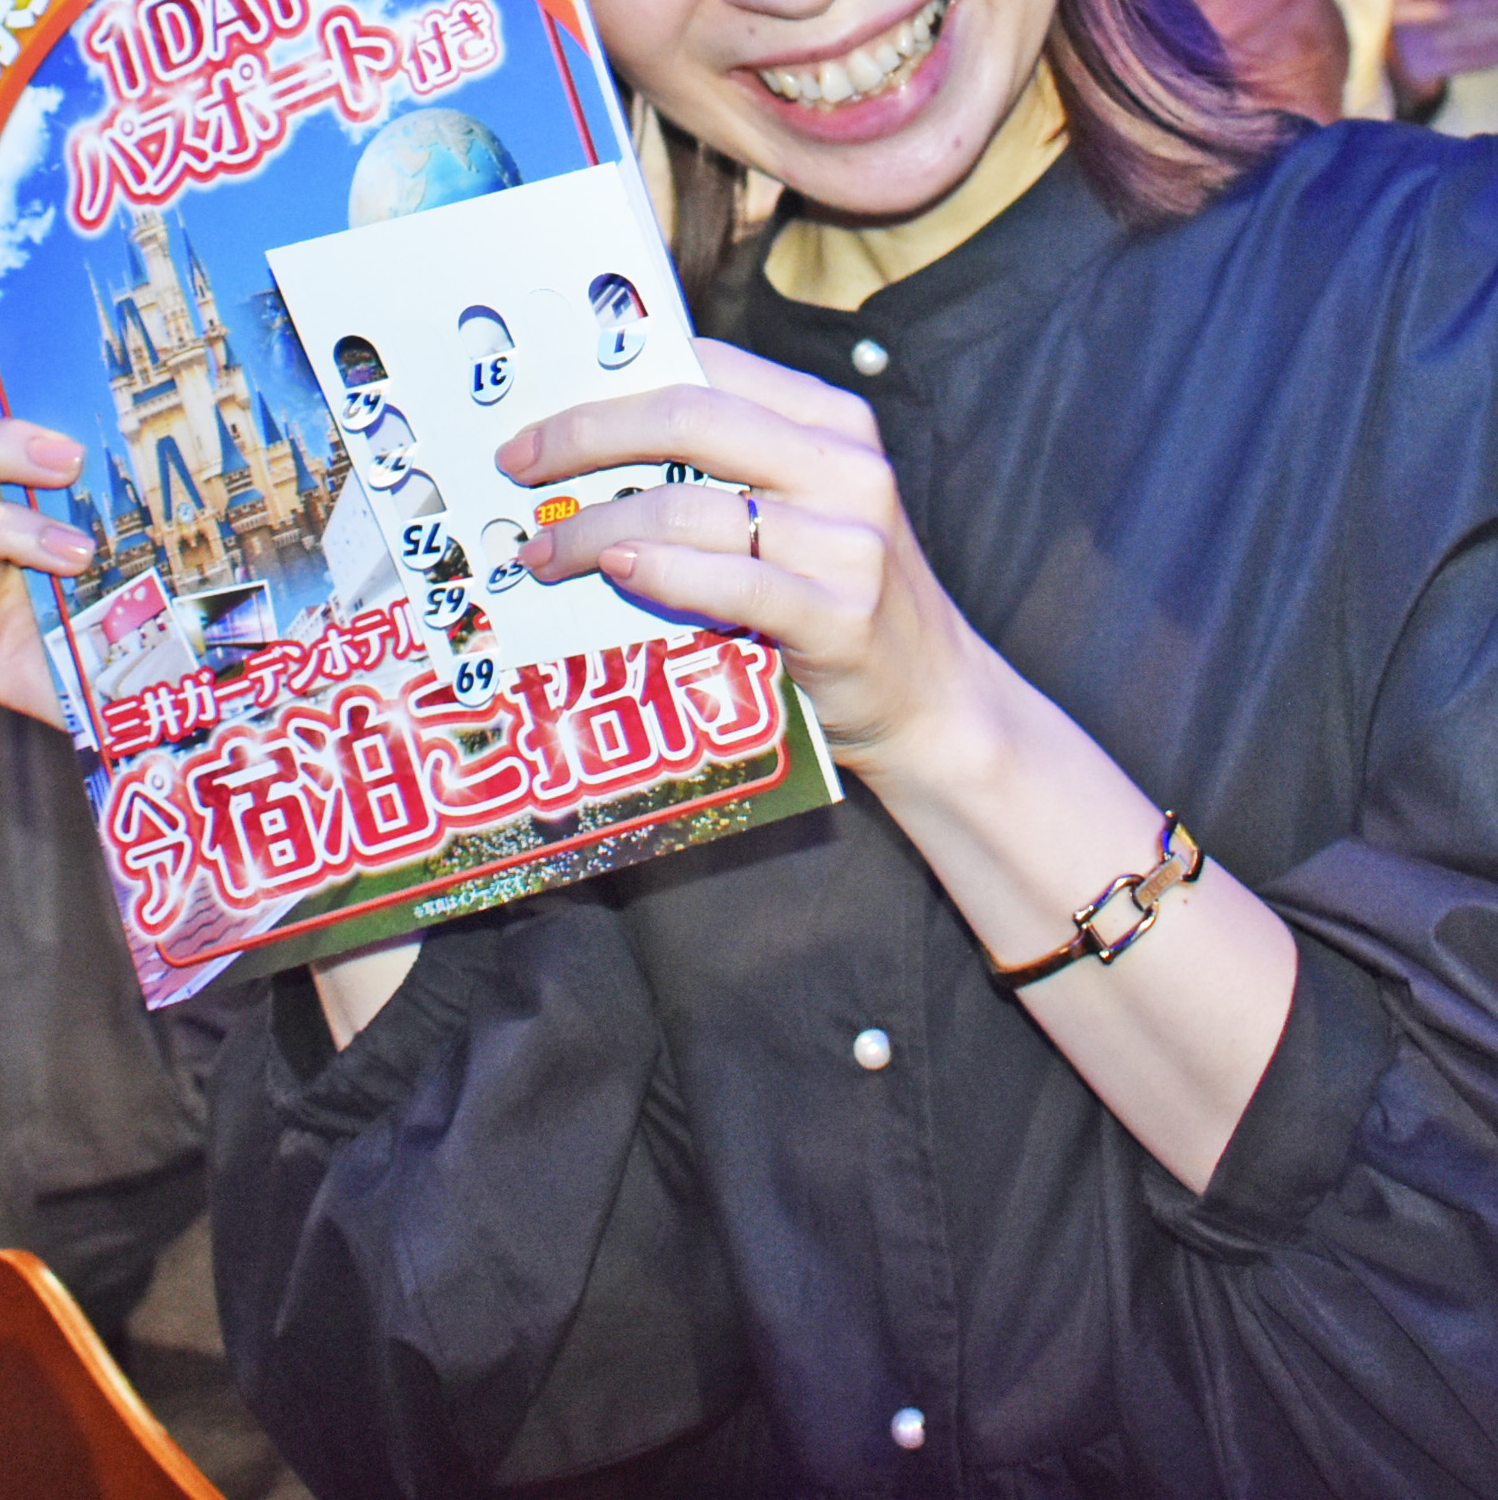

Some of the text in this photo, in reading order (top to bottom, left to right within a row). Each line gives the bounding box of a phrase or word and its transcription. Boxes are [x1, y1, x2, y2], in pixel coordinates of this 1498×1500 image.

[473, 355, 509, 393] 31
[537, 498, 577, 524] FREE
[402, 521, 443, 557] 75
[424, 585, 466, 616] 65
[456, 658, 495, 694] 69
